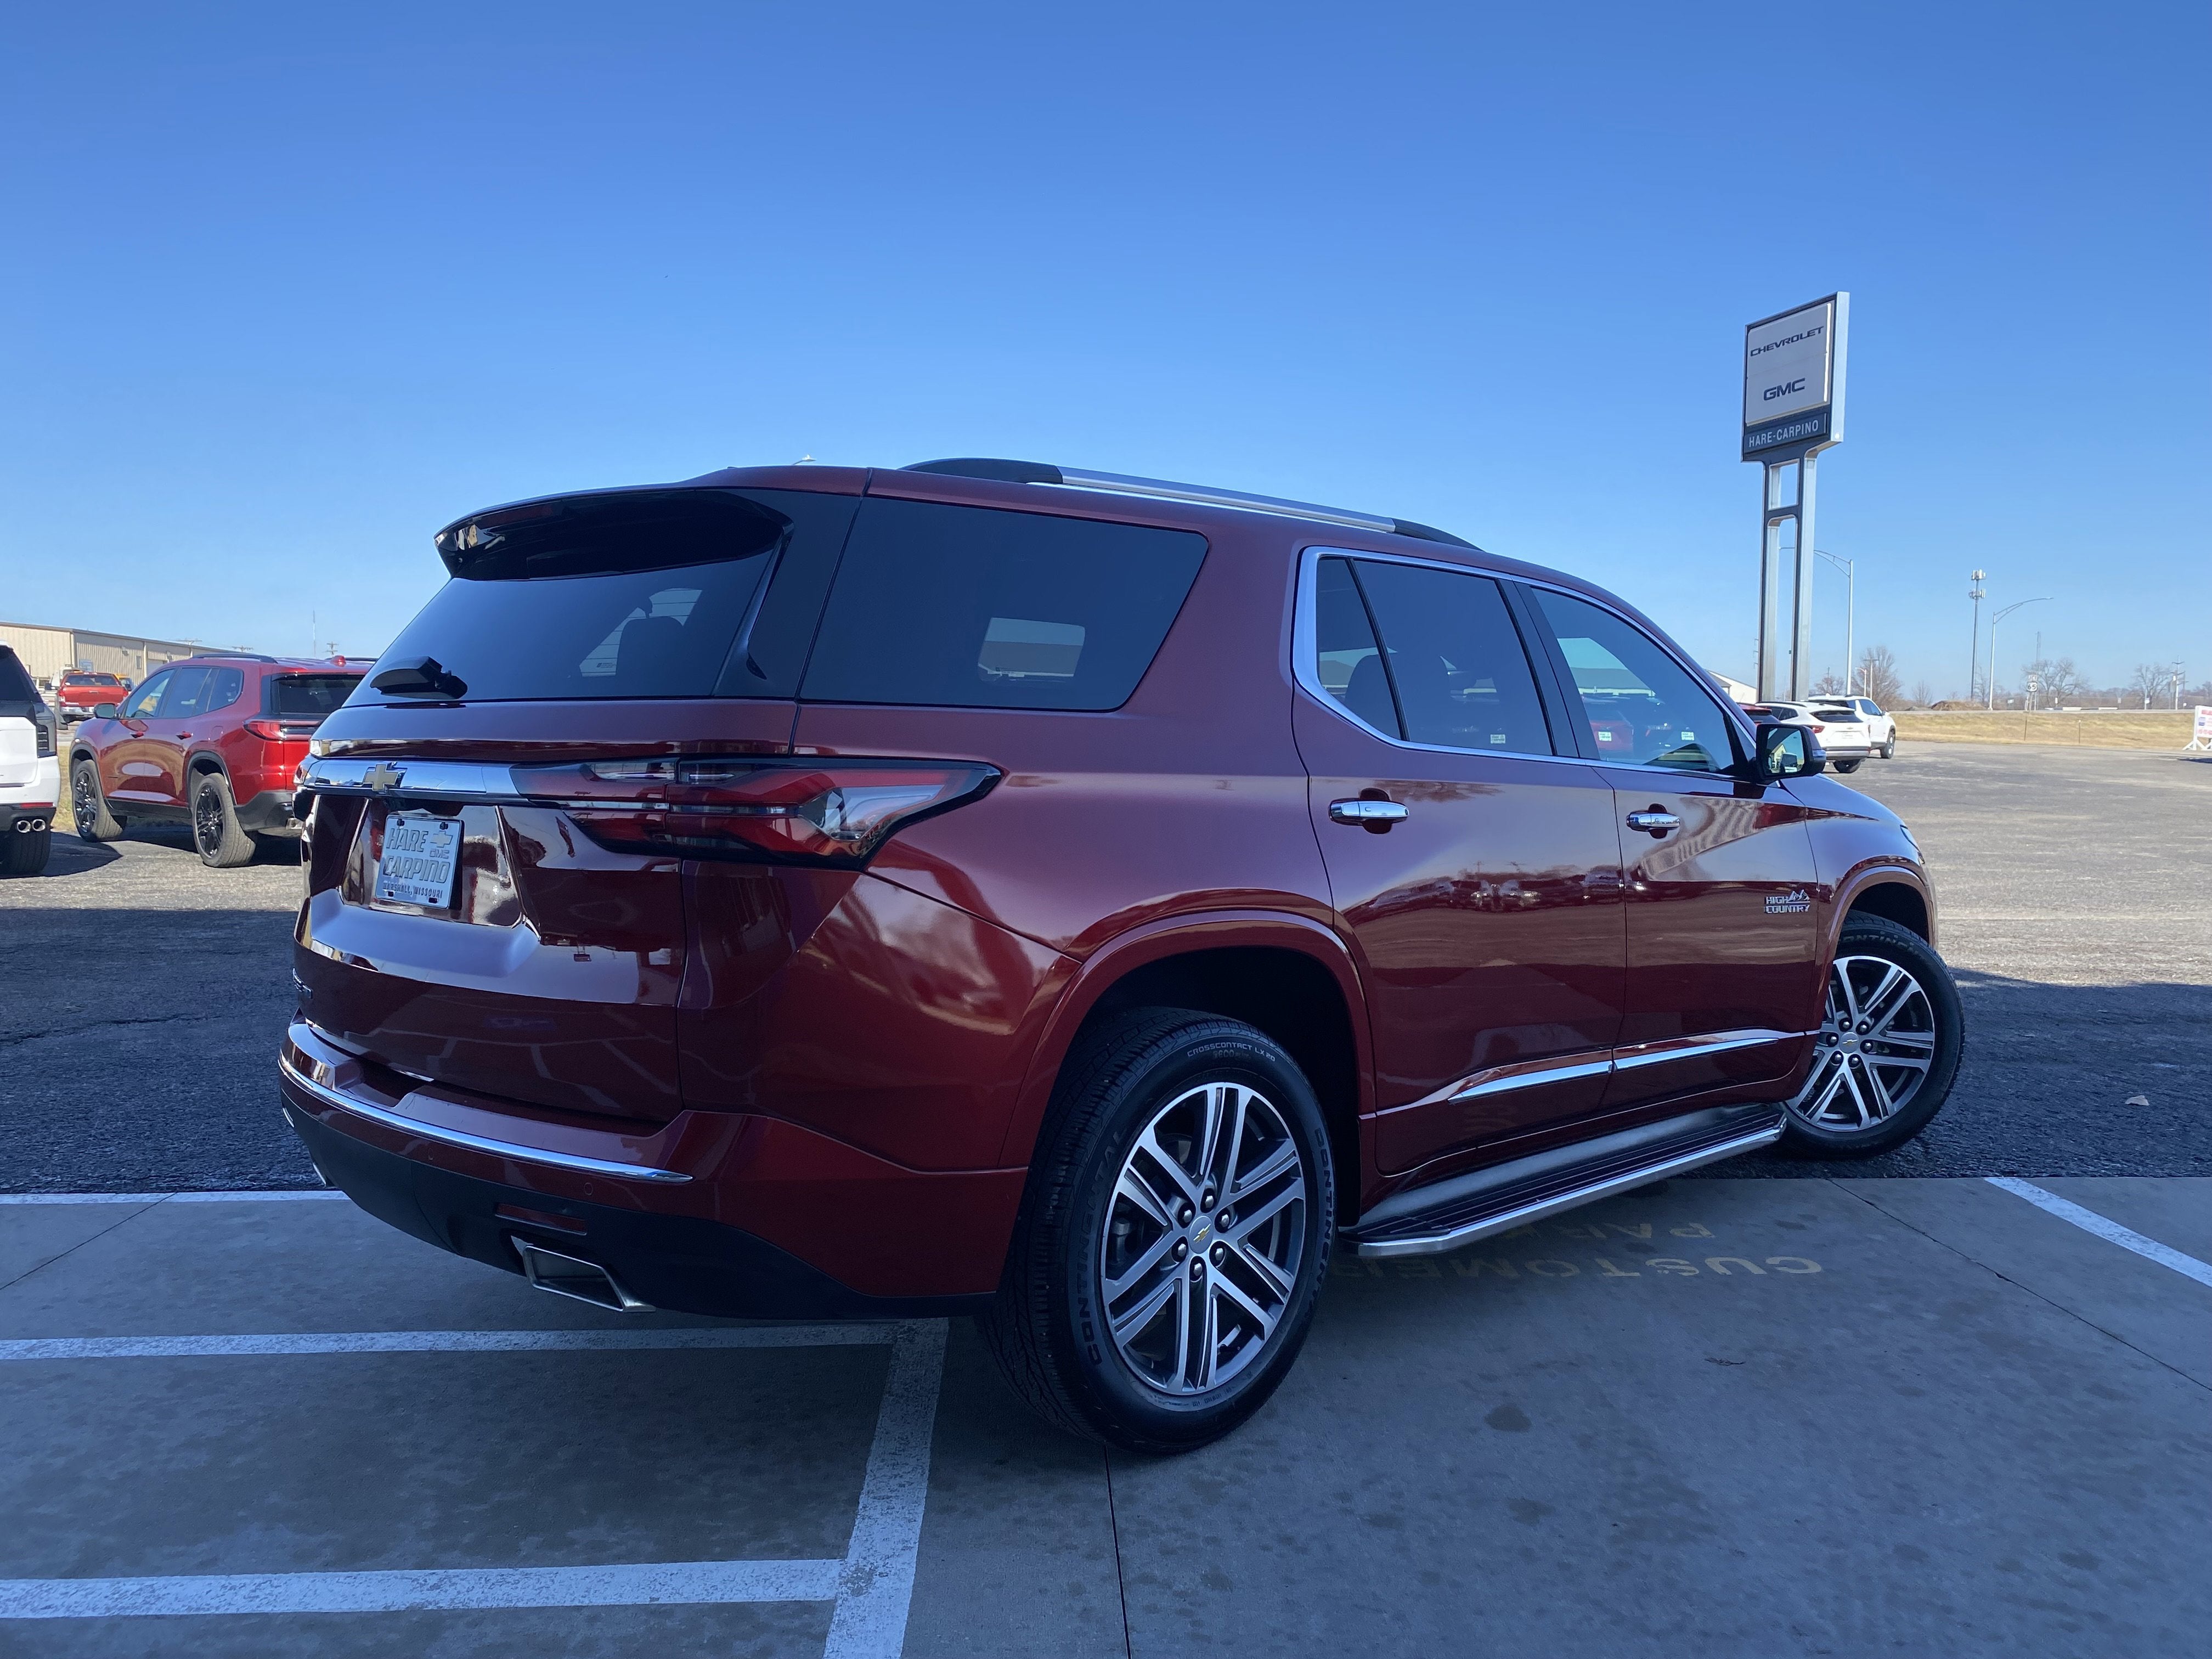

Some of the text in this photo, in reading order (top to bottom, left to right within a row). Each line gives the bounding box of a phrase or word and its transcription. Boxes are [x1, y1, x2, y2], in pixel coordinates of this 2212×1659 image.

[1750, 326, 1824, 357] CHEVROLET
[1763, 377, 1805, 401] GMC
[1748, 419, 1819, 447] HARE-CARPINO
[386, 828, 428, 853] HARE
[382, 855, 450, 883] CARPINO
[413, 885, 443, 899] MISSOURI
[1765, 895, 1789, 904] HIGH
[1764, 905, 1810, 913] COUNTRY
[1187, 1042, 1252, 1057] CROSSCONTACT
[1331, 1256, 1823, 1278] CUSTOMER
